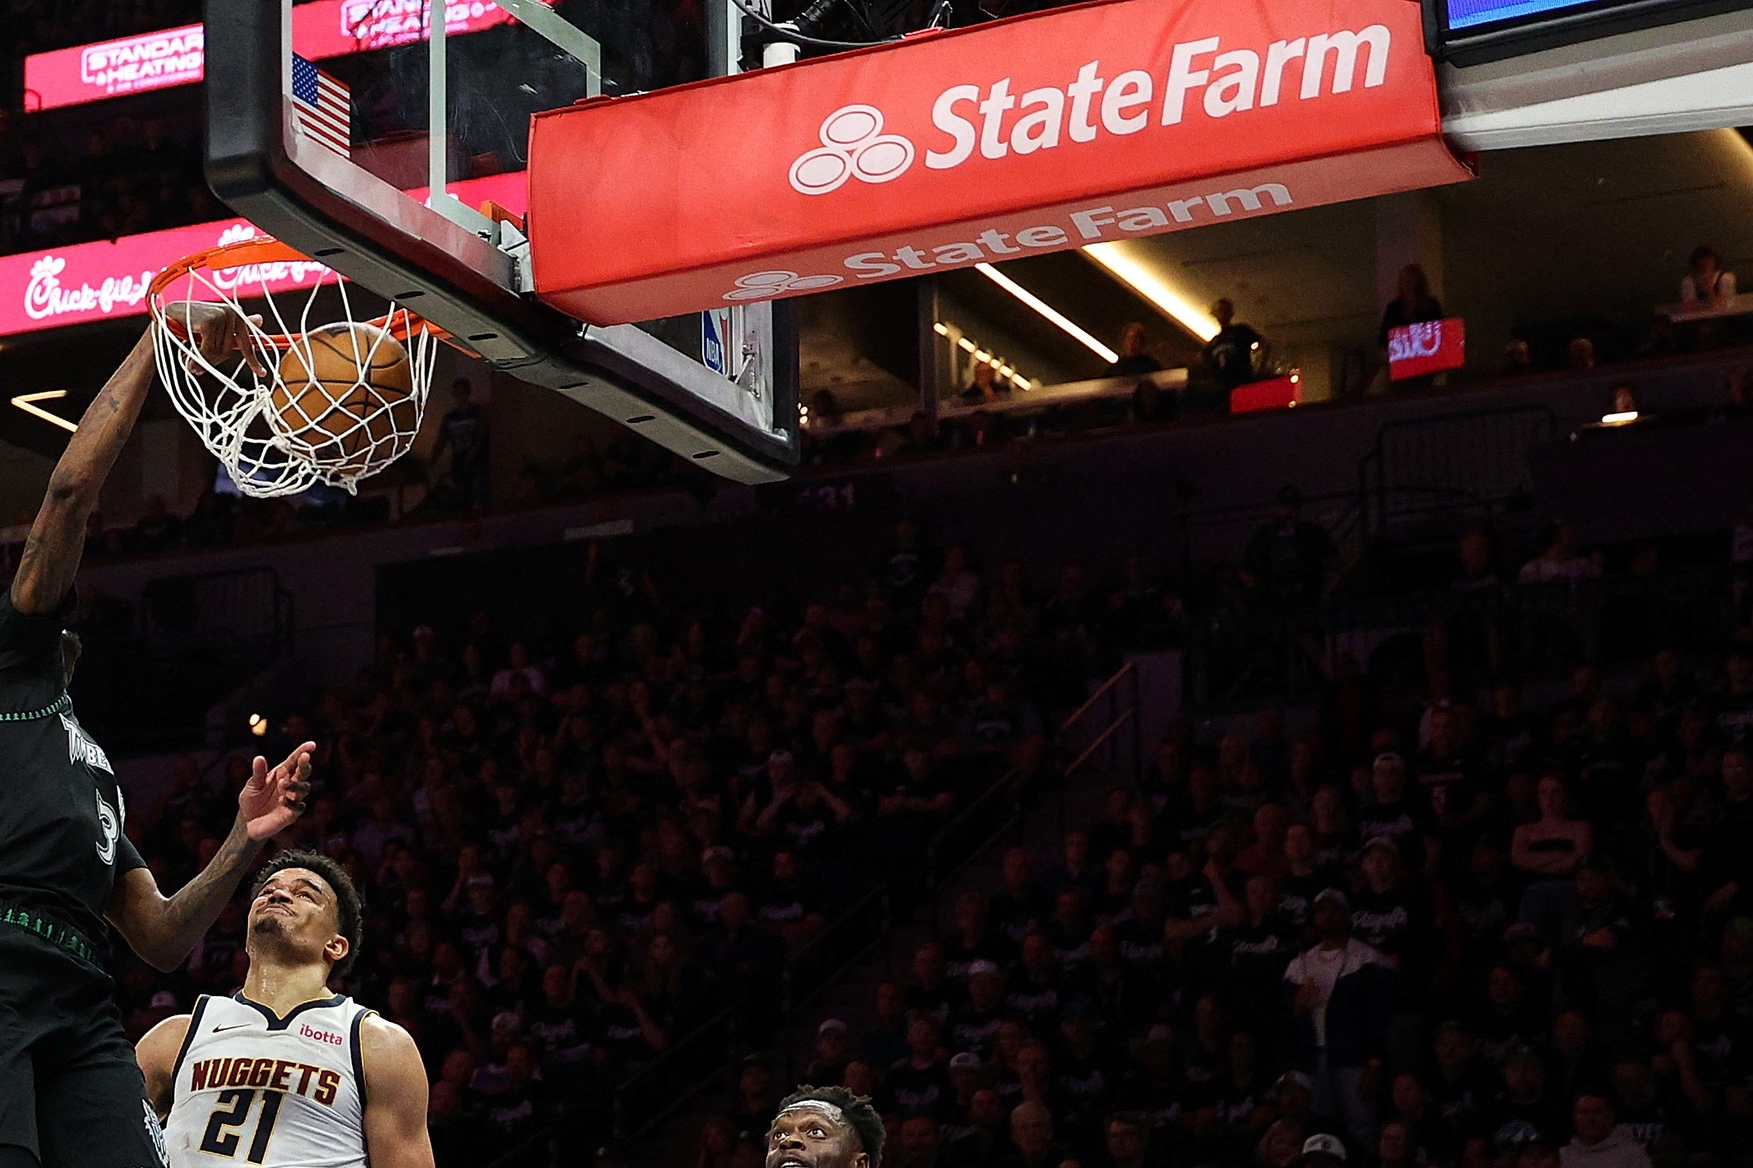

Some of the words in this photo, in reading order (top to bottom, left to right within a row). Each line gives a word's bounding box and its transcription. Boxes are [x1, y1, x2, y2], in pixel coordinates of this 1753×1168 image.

[88, 34, 204, 70] STANDAR
[106, 51, 202, 83] HEATING
[299, 1023, 343, 1046] ibotta
[190, 1057, 342, 1108] NUGGETS
[197, 1088, 286, 1167] 21
